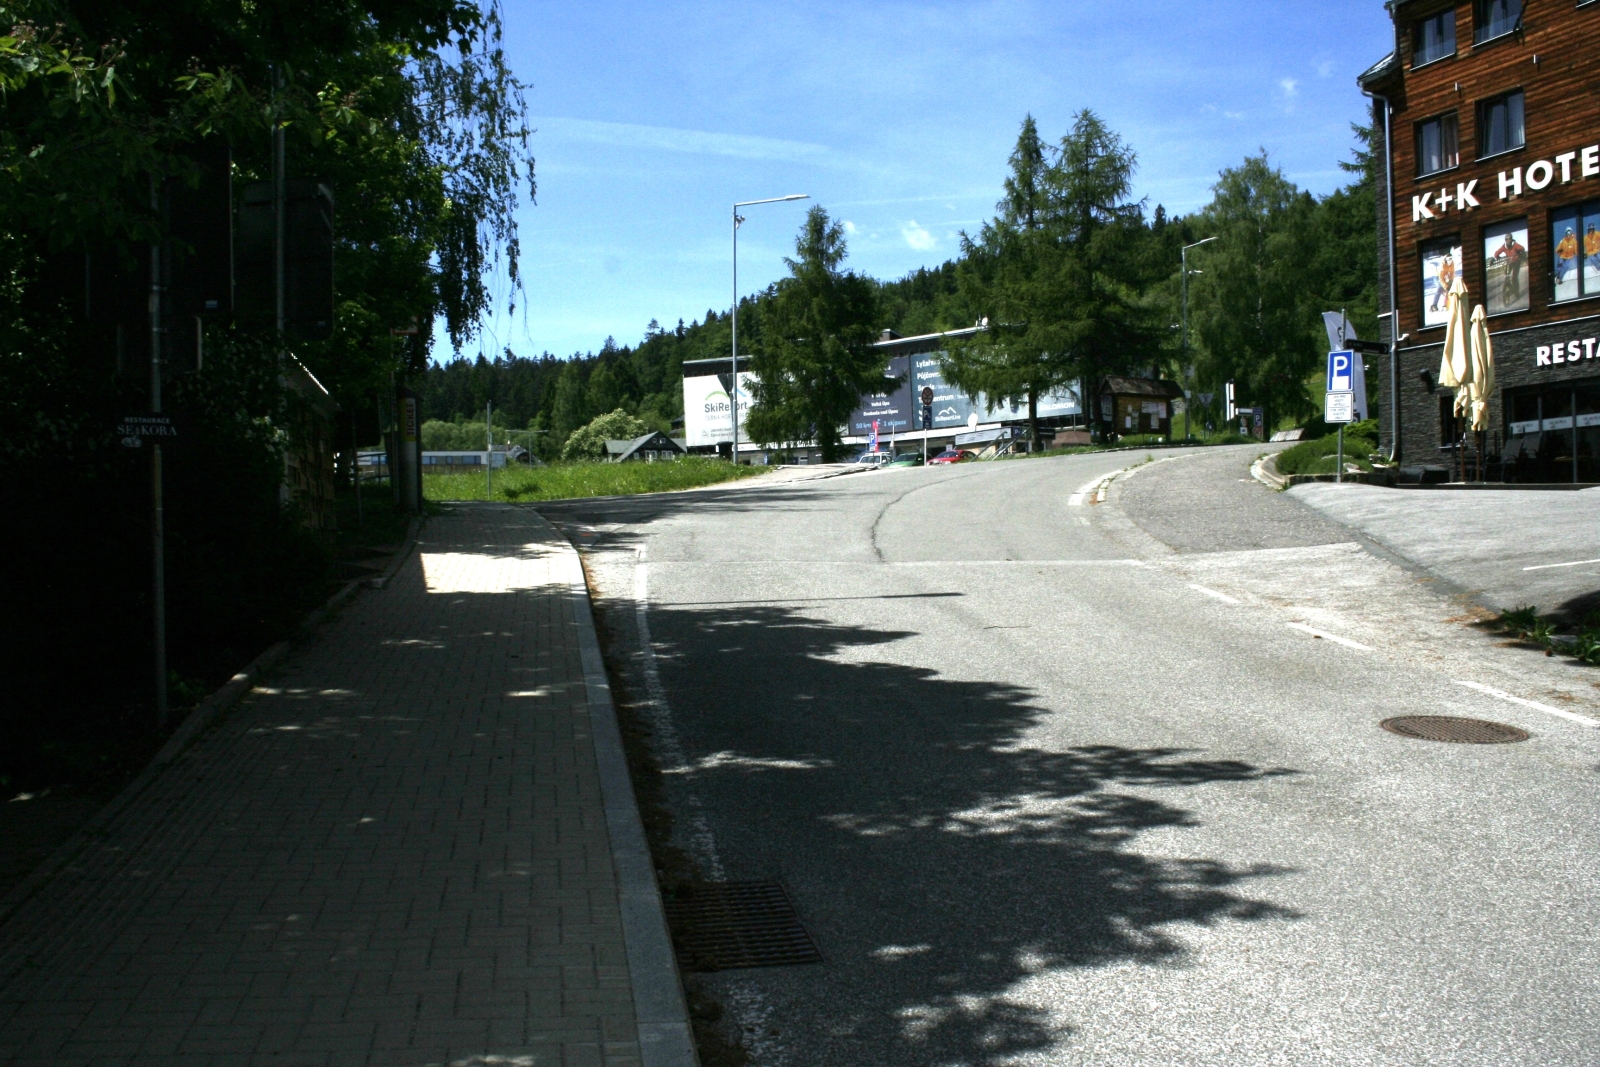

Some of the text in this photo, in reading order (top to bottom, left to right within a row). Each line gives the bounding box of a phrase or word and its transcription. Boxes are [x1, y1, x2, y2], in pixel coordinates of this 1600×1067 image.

[1412, 179, 1480, 222] K+K
[1333, 355, 1348, 377] P
[704, 401, 748, 413] SkiReort
[124, 416, 170, 424] RESTAURACE
[406, 402, 415, 436] TICKET
